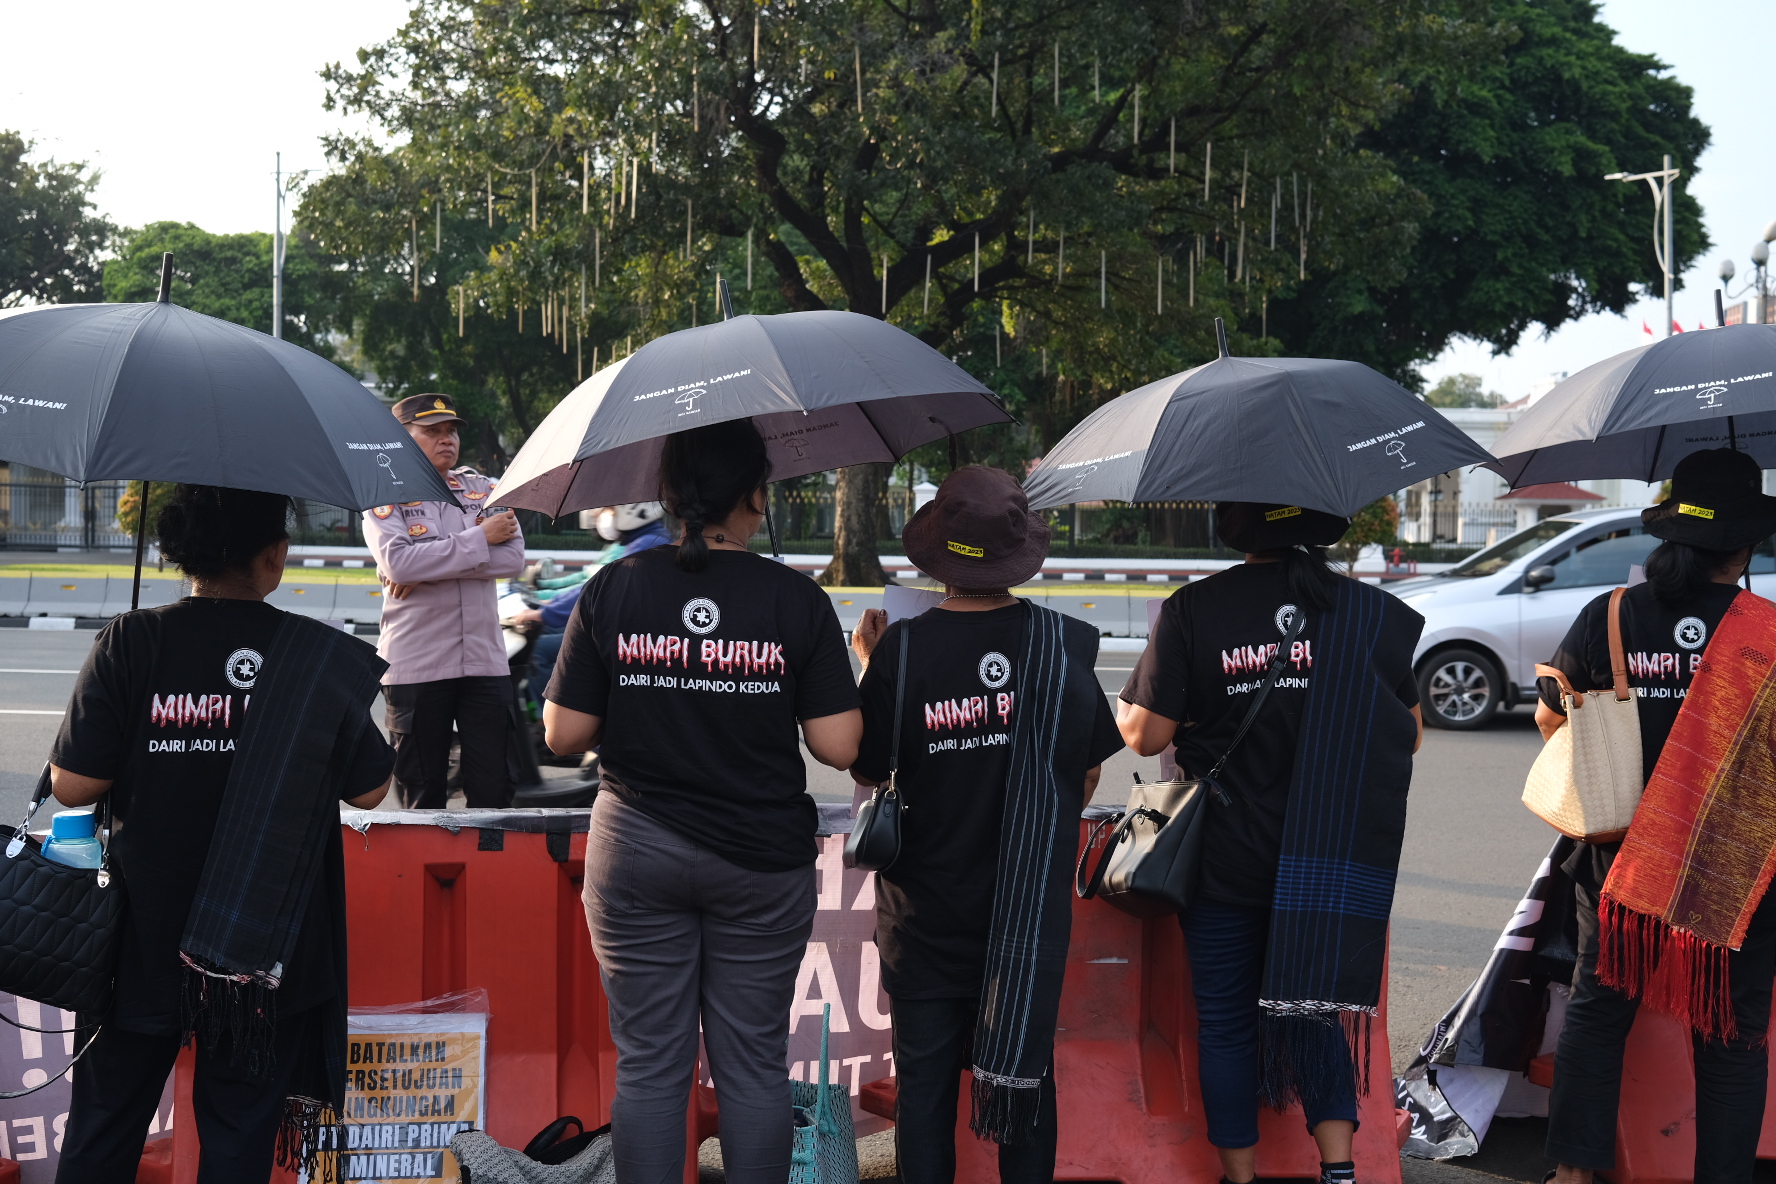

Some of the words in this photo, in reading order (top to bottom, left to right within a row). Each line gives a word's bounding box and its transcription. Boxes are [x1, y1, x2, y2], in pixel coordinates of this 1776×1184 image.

[1653, 384, 1695, 395] JANGAN
[617, 632, 690, 669] MIMPI
[700, 638, 786, 676] BURUK
[619, 673, 650, 687] DAIRI
[653, 675, 677, 689] JADI
[680, 678, 736, 693] LAPINDO
[739, 681, 781, 694] KEDUA
[1650, 687, 1670, 698] JADI
[151, 692, 232, 729] MIMPI
[924, 694, 988, 731] MIMPI
[148, 739, 185, 752] DAIRI
[189, 738, 216, 752] JADI
[929, 739, 957, 754] DAIRI
[960, 736, 980, 750] JADI
[350, 1040, 446, 1065] BATALKAN
[346, 1067, 463, 1091] ERSETUJUAN
[346, 1094, 455, 1119] INGKUNGAN
[347, 1124, 400, 1149] DAIRI
[349, 1153, 436, 1178] MINERAL
